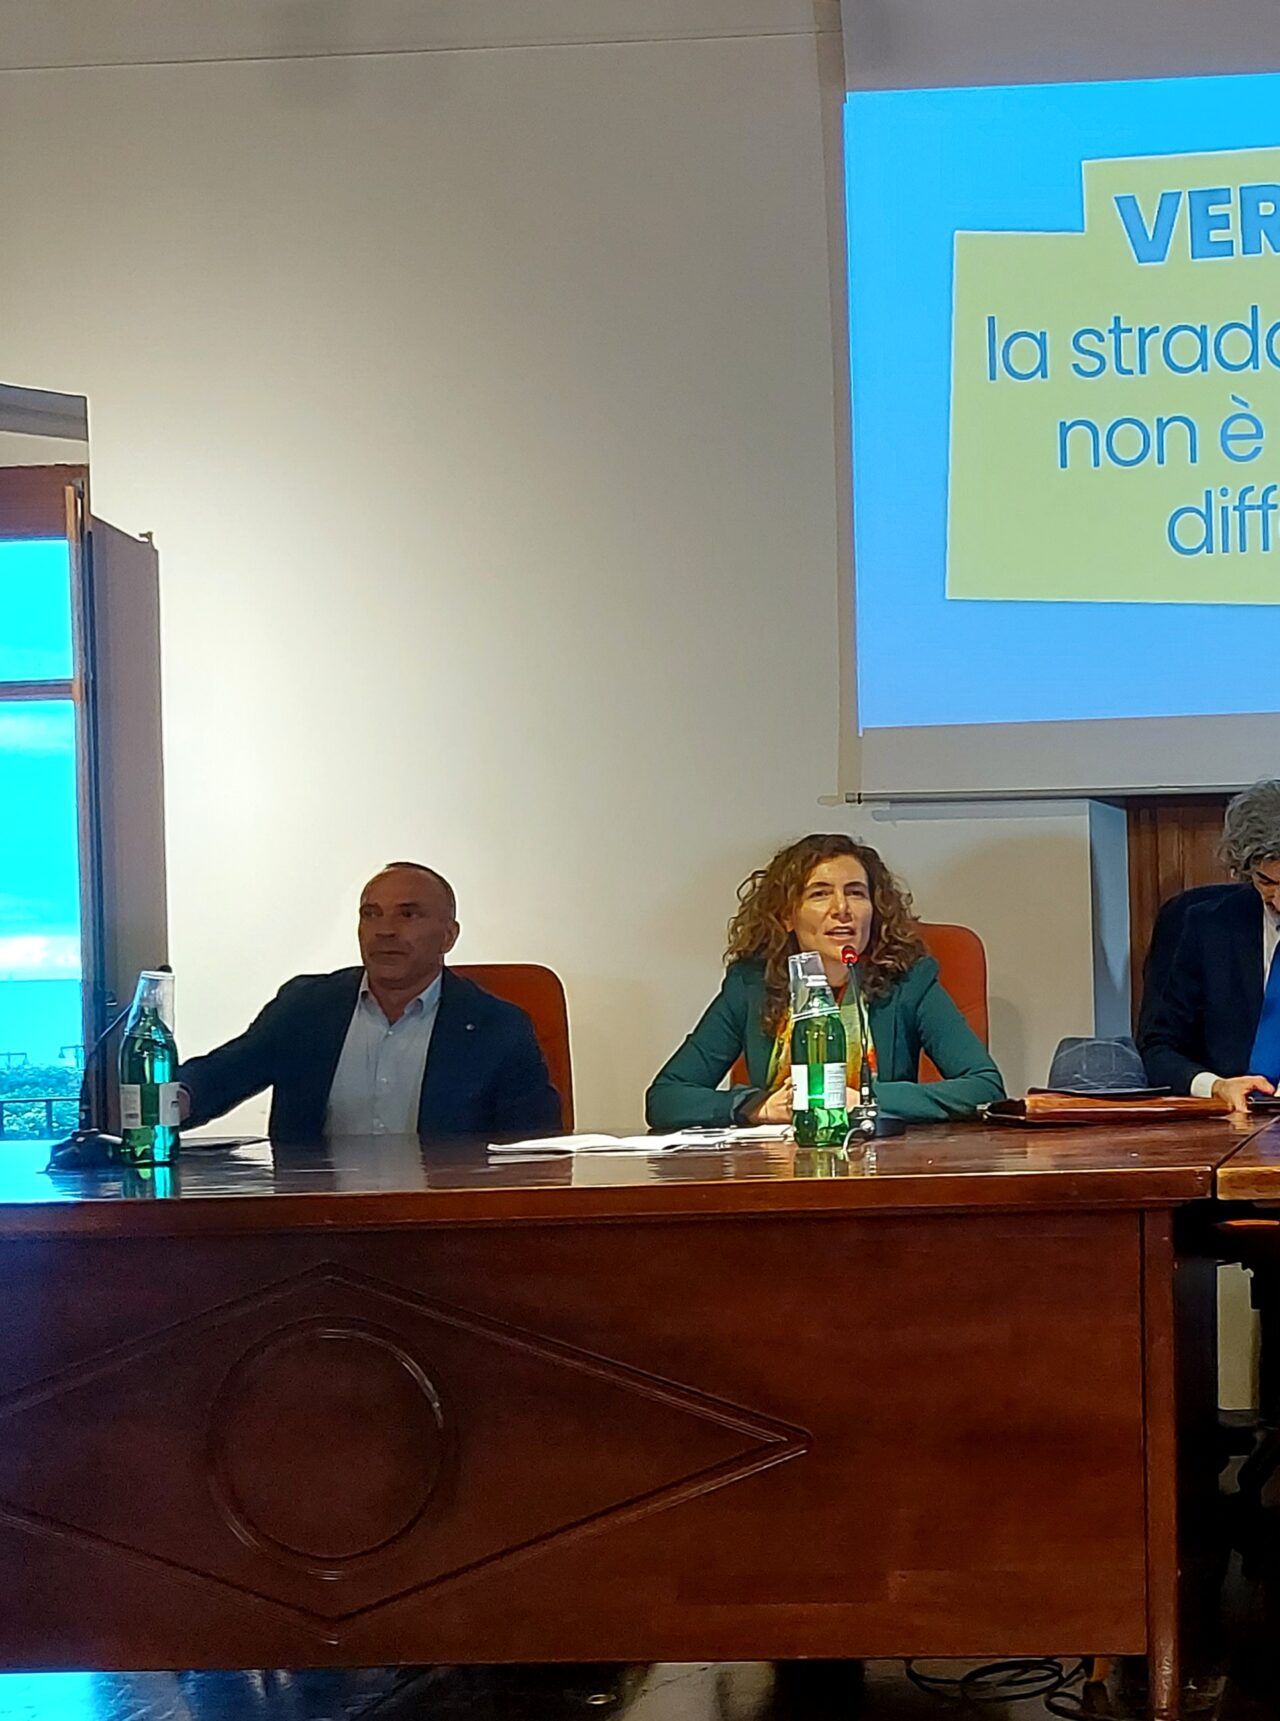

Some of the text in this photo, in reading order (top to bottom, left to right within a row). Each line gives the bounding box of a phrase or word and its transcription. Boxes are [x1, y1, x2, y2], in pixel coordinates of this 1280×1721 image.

[987, 315, 1049, 381] la
[1058, 412, 1198, 469] non
[1219, 394, 1264, 463] è
